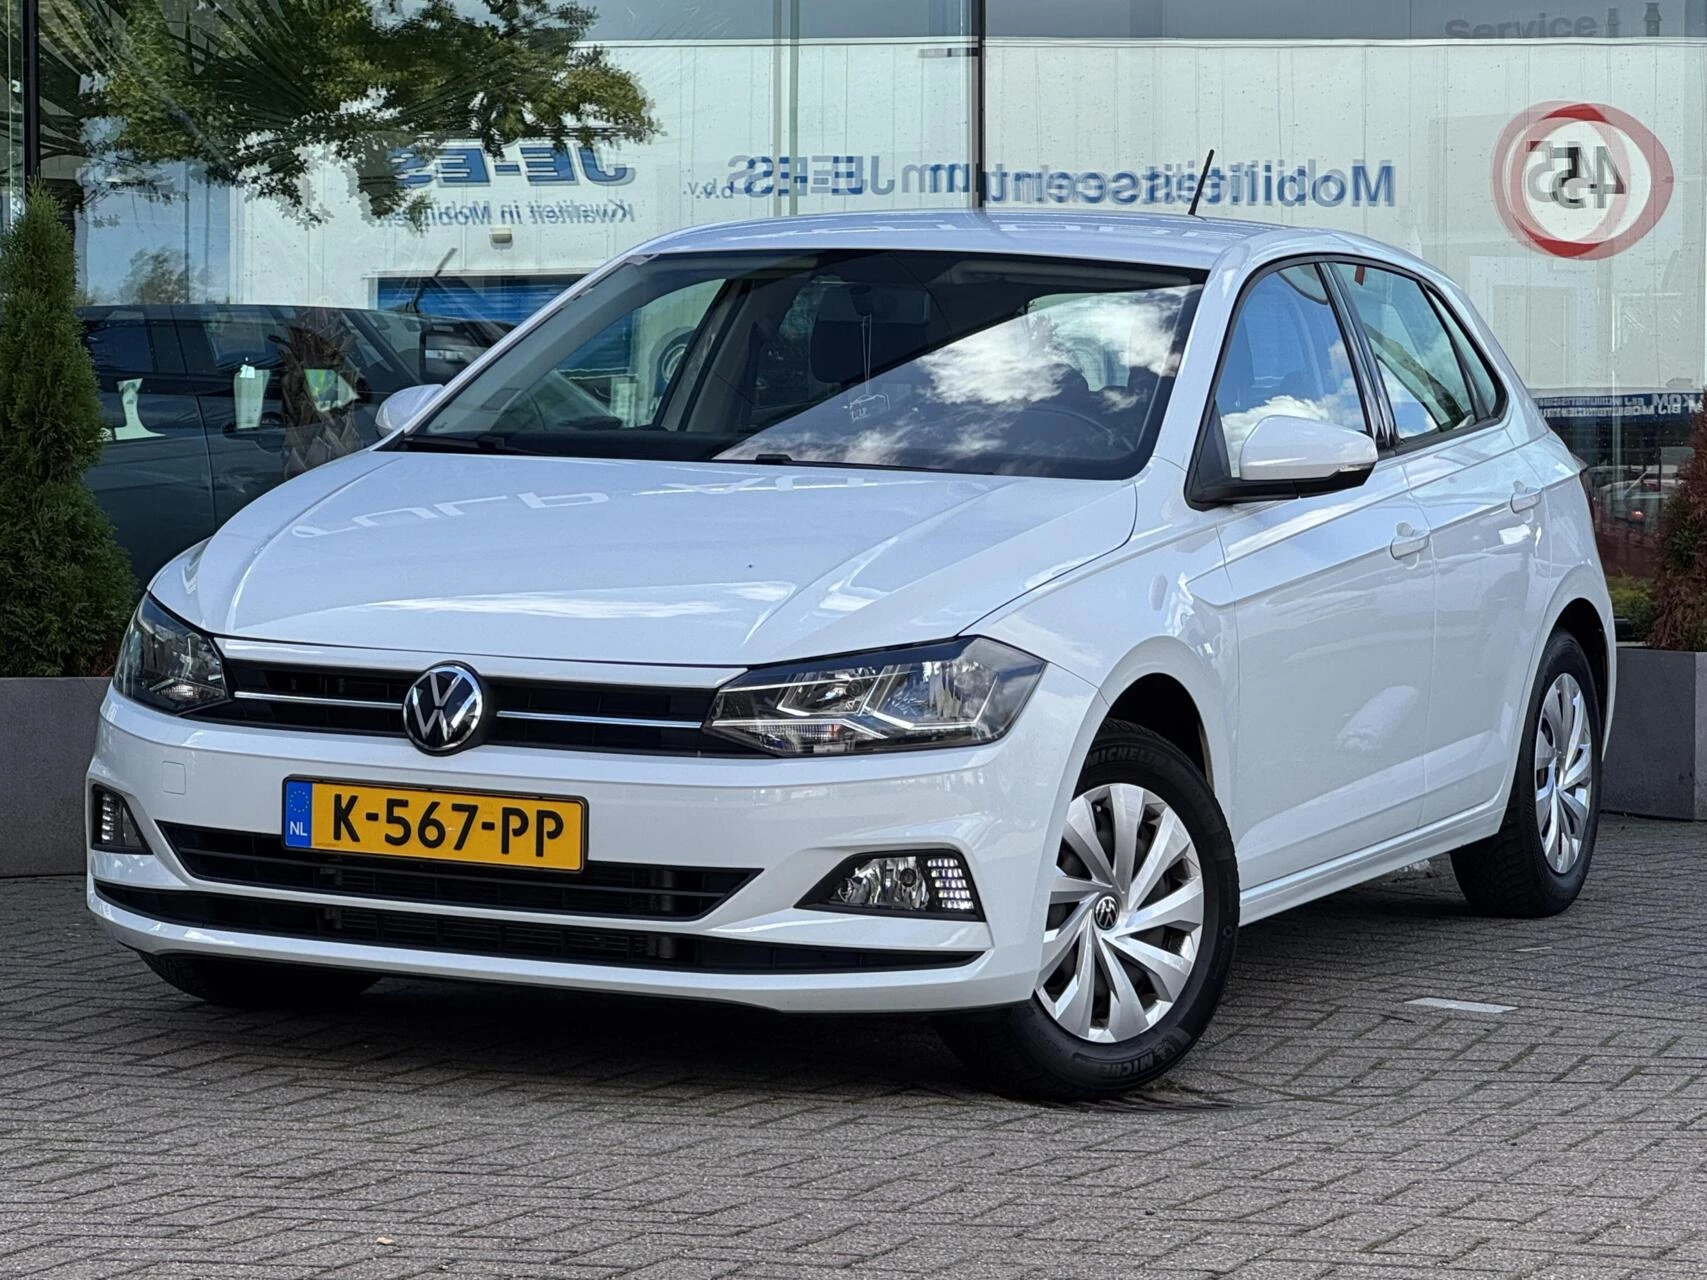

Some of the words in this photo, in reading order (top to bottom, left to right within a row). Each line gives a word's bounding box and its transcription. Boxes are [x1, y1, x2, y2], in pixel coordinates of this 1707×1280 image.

[1444, 12, 1599, 38] Service
[289, 820, 308, 837] NL
[332, 792, 565, 858] K-567-PP
